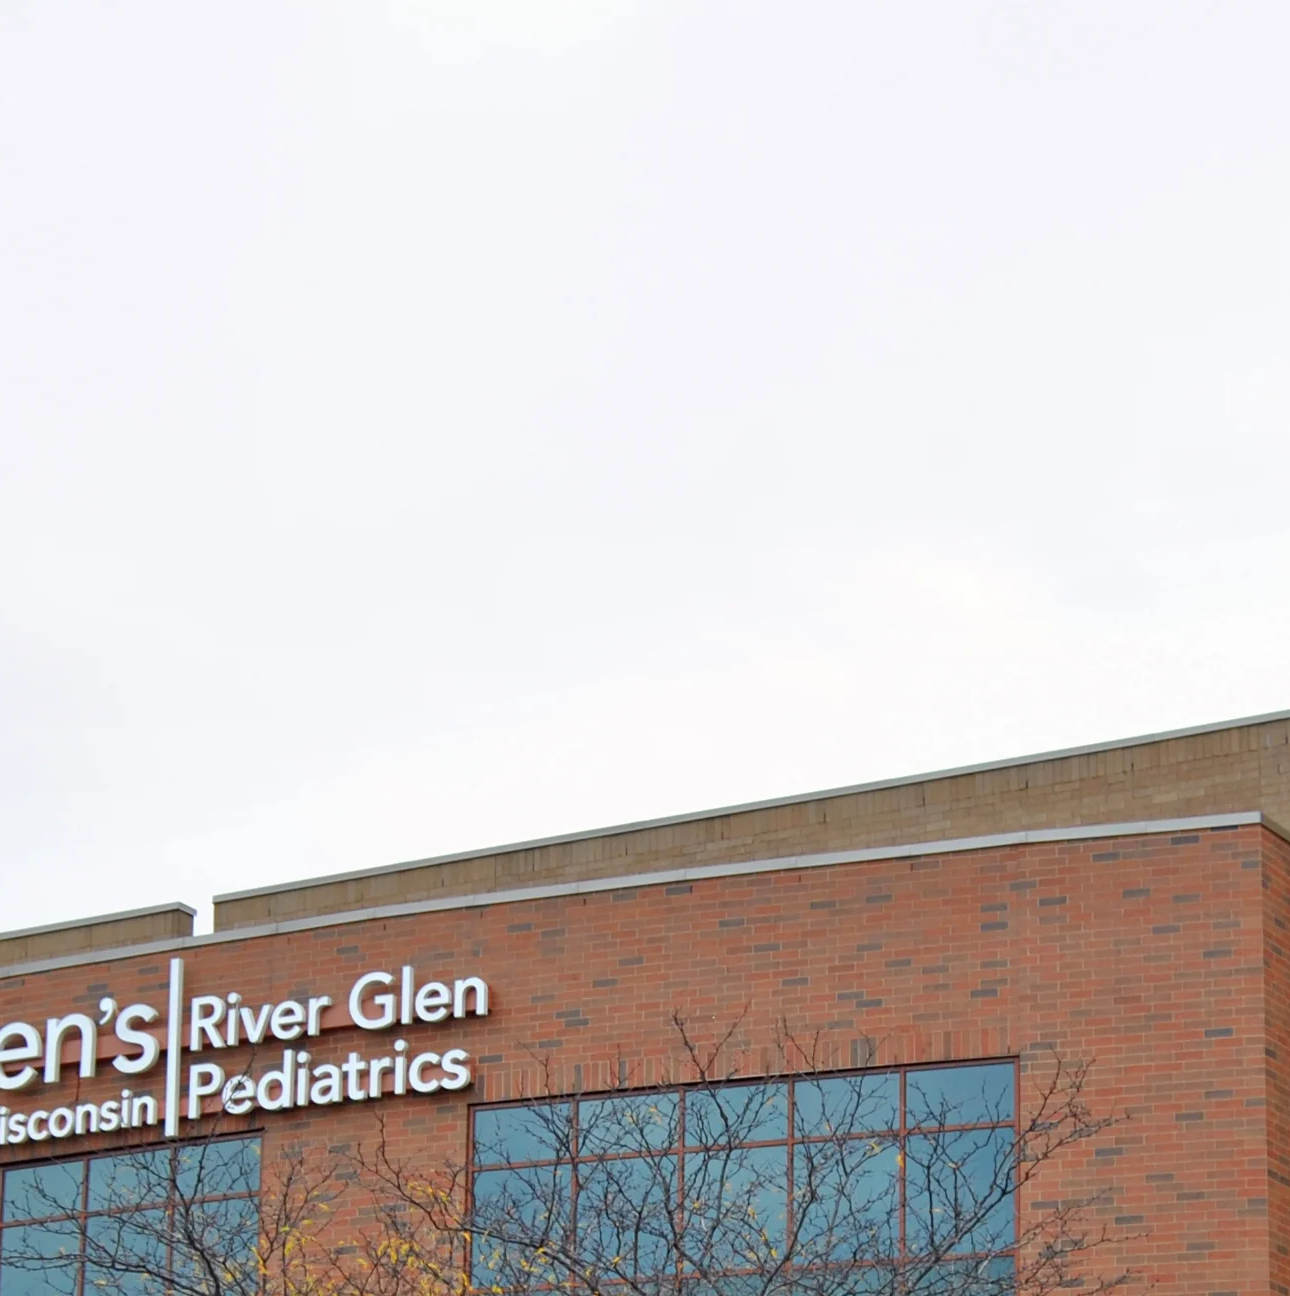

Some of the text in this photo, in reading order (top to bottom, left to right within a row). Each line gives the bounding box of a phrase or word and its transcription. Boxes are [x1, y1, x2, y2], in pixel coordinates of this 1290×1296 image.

[190, 965, 489, 1052] River Glen
[188, 1039, 472, 1119] Pediatrics
